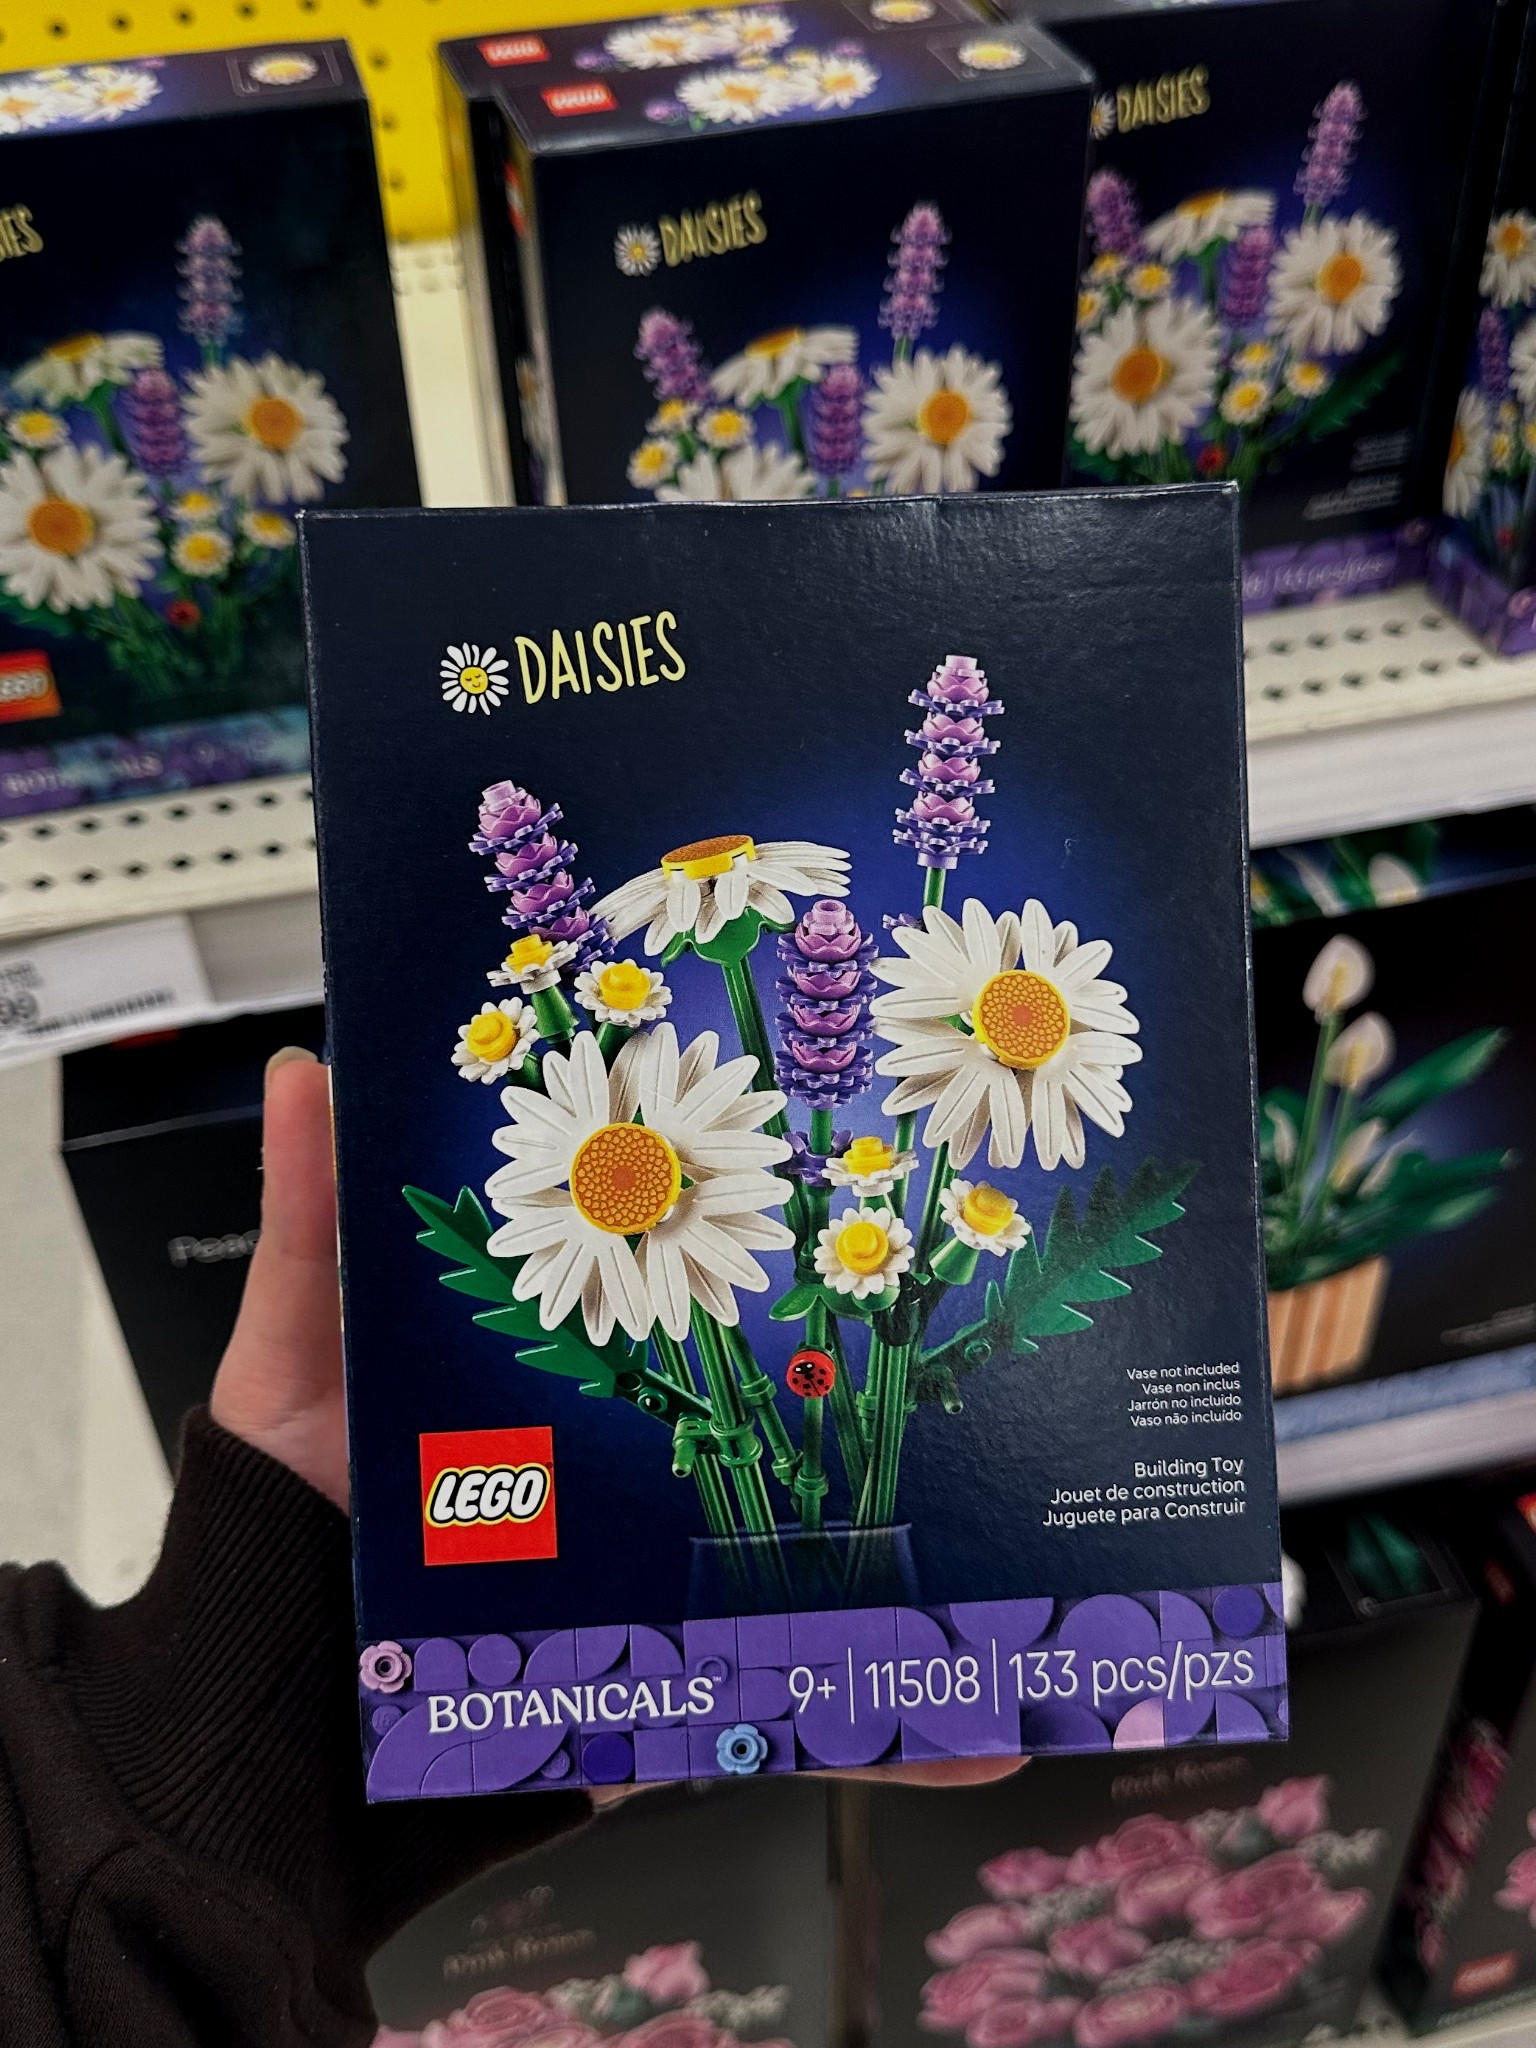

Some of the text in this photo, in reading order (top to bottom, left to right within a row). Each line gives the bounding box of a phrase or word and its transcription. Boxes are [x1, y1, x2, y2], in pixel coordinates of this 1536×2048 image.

[1116, 66, 1210, 133] DAISIES
[658, 191, 767, 267] DAISIES
[514, 610, 686, 704] DAISIES
[1127, 1362, 1240, 1380] Vase not included
[1142, 1378, 1241, 1395] Vase non inclus
[1128, 1398, 1168, 1411] Jarrón
[1171, 1399, 1188, 1409] no
[1130, 1415, 1162, 1427] Vaso
[1164, 1413, 1189, 1425] não
[1134, 1457, 1244, 1478] Building Toy
[429, 1466, 548, 1523] LEGO
[1050, 1478, 1246, 1504] Jouet de construction
[1043, 1498, 1246, 1529] Juguete para Construir
[788, 1640, 1255, 1713] 9+ 11508 133 pcs/pzs
